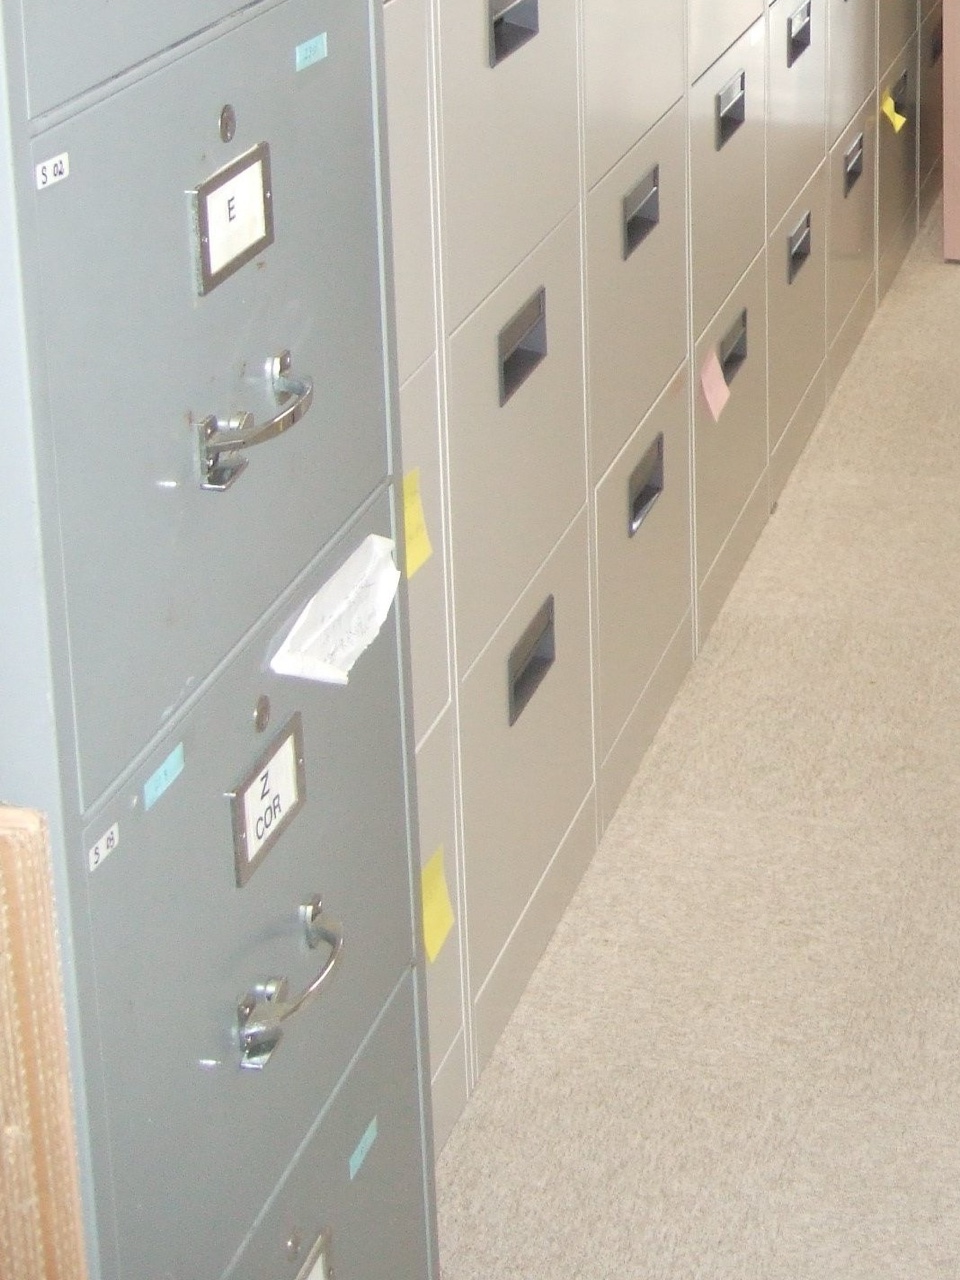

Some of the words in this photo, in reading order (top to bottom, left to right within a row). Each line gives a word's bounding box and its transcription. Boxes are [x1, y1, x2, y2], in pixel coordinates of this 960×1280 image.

[41, 165, 48, 185] S
[53, 160, 65, 177] 02
[227, 195, 236, 223] E
[260, 770, 270, 800] Z
[255, 793, 282, 840] COR
[94, 846, 100, 865] S
